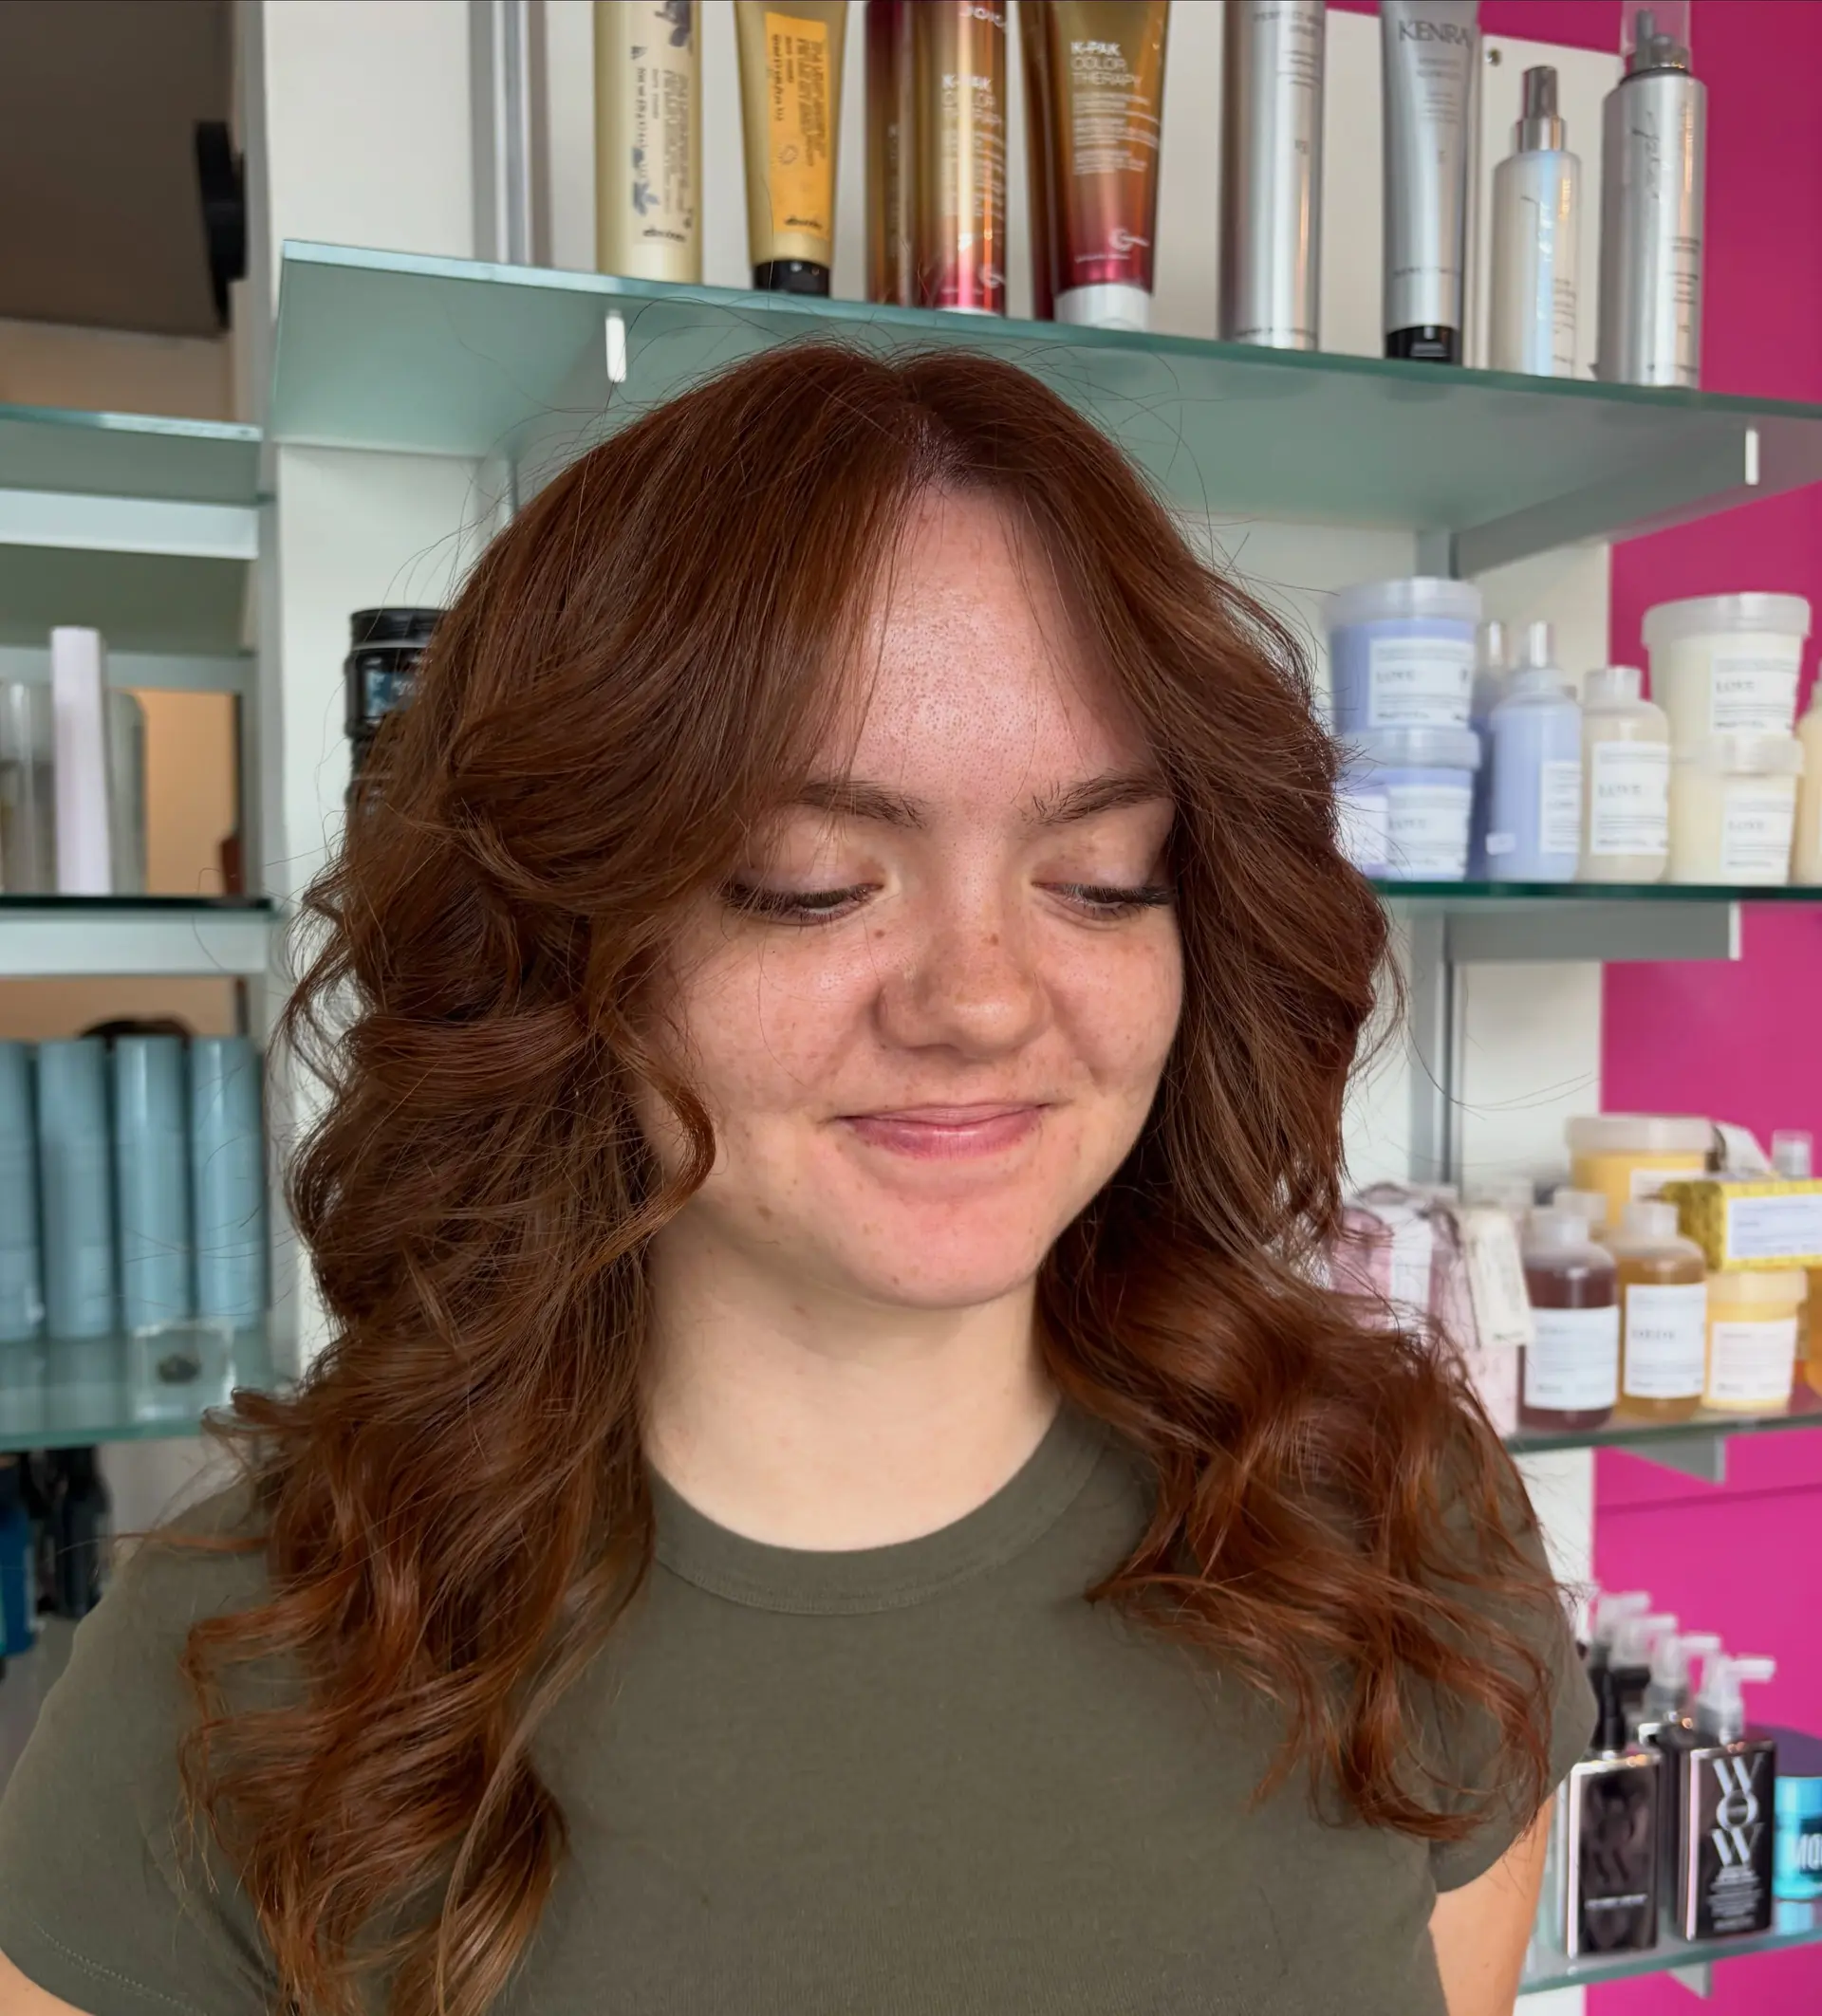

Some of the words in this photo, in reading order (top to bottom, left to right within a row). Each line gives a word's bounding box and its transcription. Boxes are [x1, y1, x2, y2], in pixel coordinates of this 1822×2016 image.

[1398, 20, 1474, 49] KENRA
[1069, 41, 1121, 56] K-PAK
[1069, 56, 1127, 74] COLOR
[1072, 71, 1143, 87] THERAPY
[1716, 680, 1755, 694] LOVE
[1598, 784, 1642, 798] LOVE
